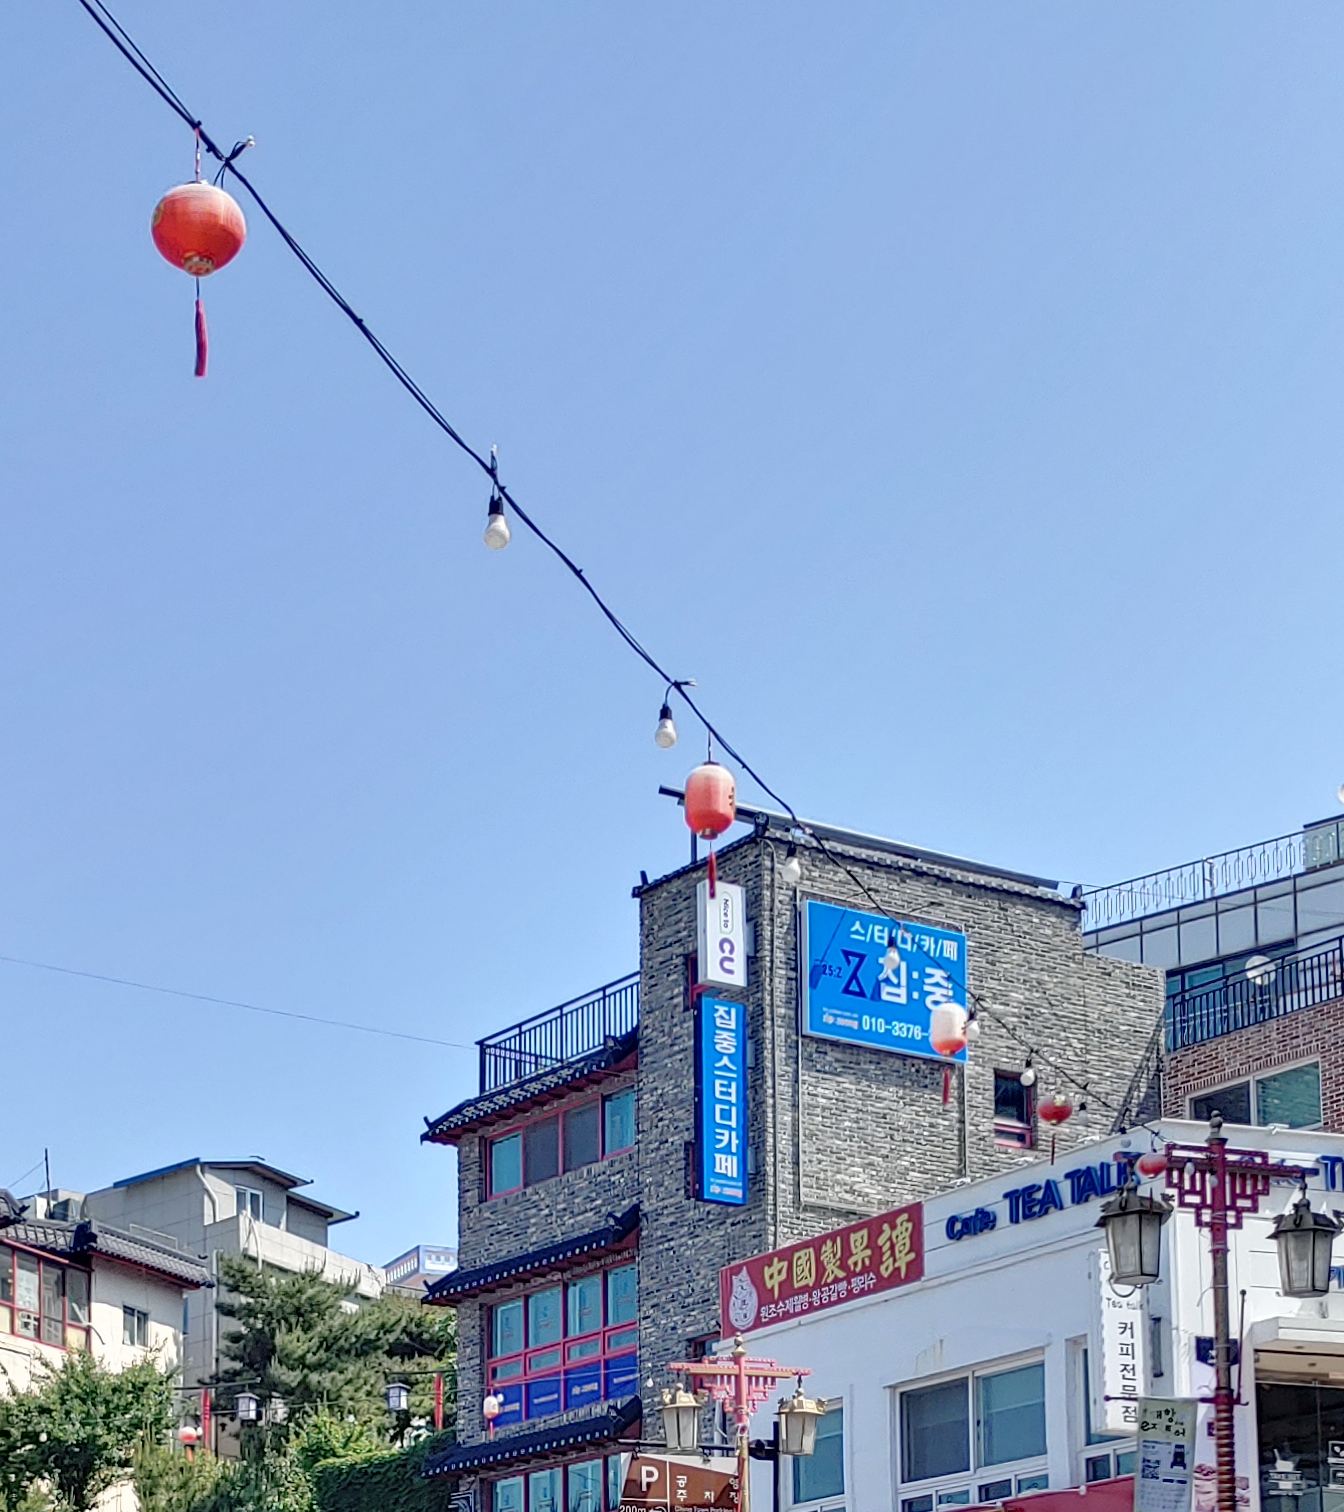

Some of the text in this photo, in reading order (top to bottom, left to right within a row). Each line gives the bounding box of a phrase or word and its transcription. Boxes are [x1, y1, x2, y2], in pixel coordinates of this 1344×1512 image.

[718, 938, 736, 976] CU
[713, 1004, 739, 1178] 집중스터디카페
[945, 1207, 997, 1240] Cafe
[1002, 1179, 1064, 1224] TEA
[763, 1213, 916, 1300] 中國製果譚
[1117, 1320, 1139, 1424] 커피전문점
[640, 1466, 659, 1491] P
